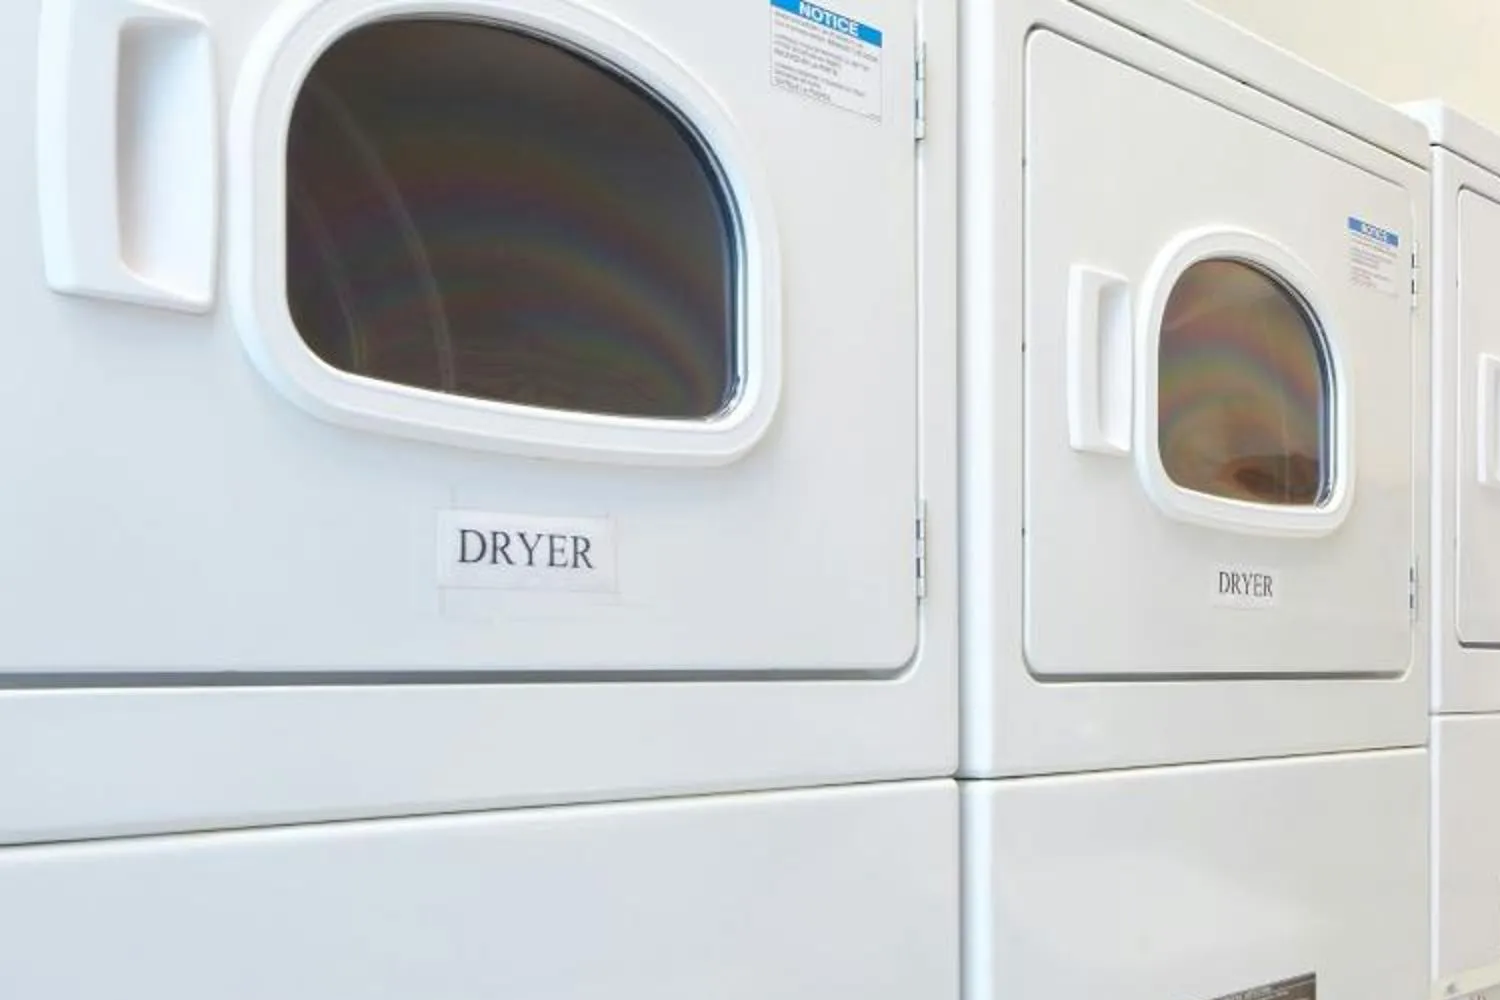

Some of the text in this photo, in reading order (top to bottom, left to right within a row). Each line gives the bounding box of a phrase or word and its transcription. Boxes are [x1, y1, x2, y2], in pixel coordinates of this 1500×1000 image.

[799, 0, 860, 38] NOTICE
[457, 528, 596, 569] DRYER
[1218, 571, 1273, 598] DRYER
